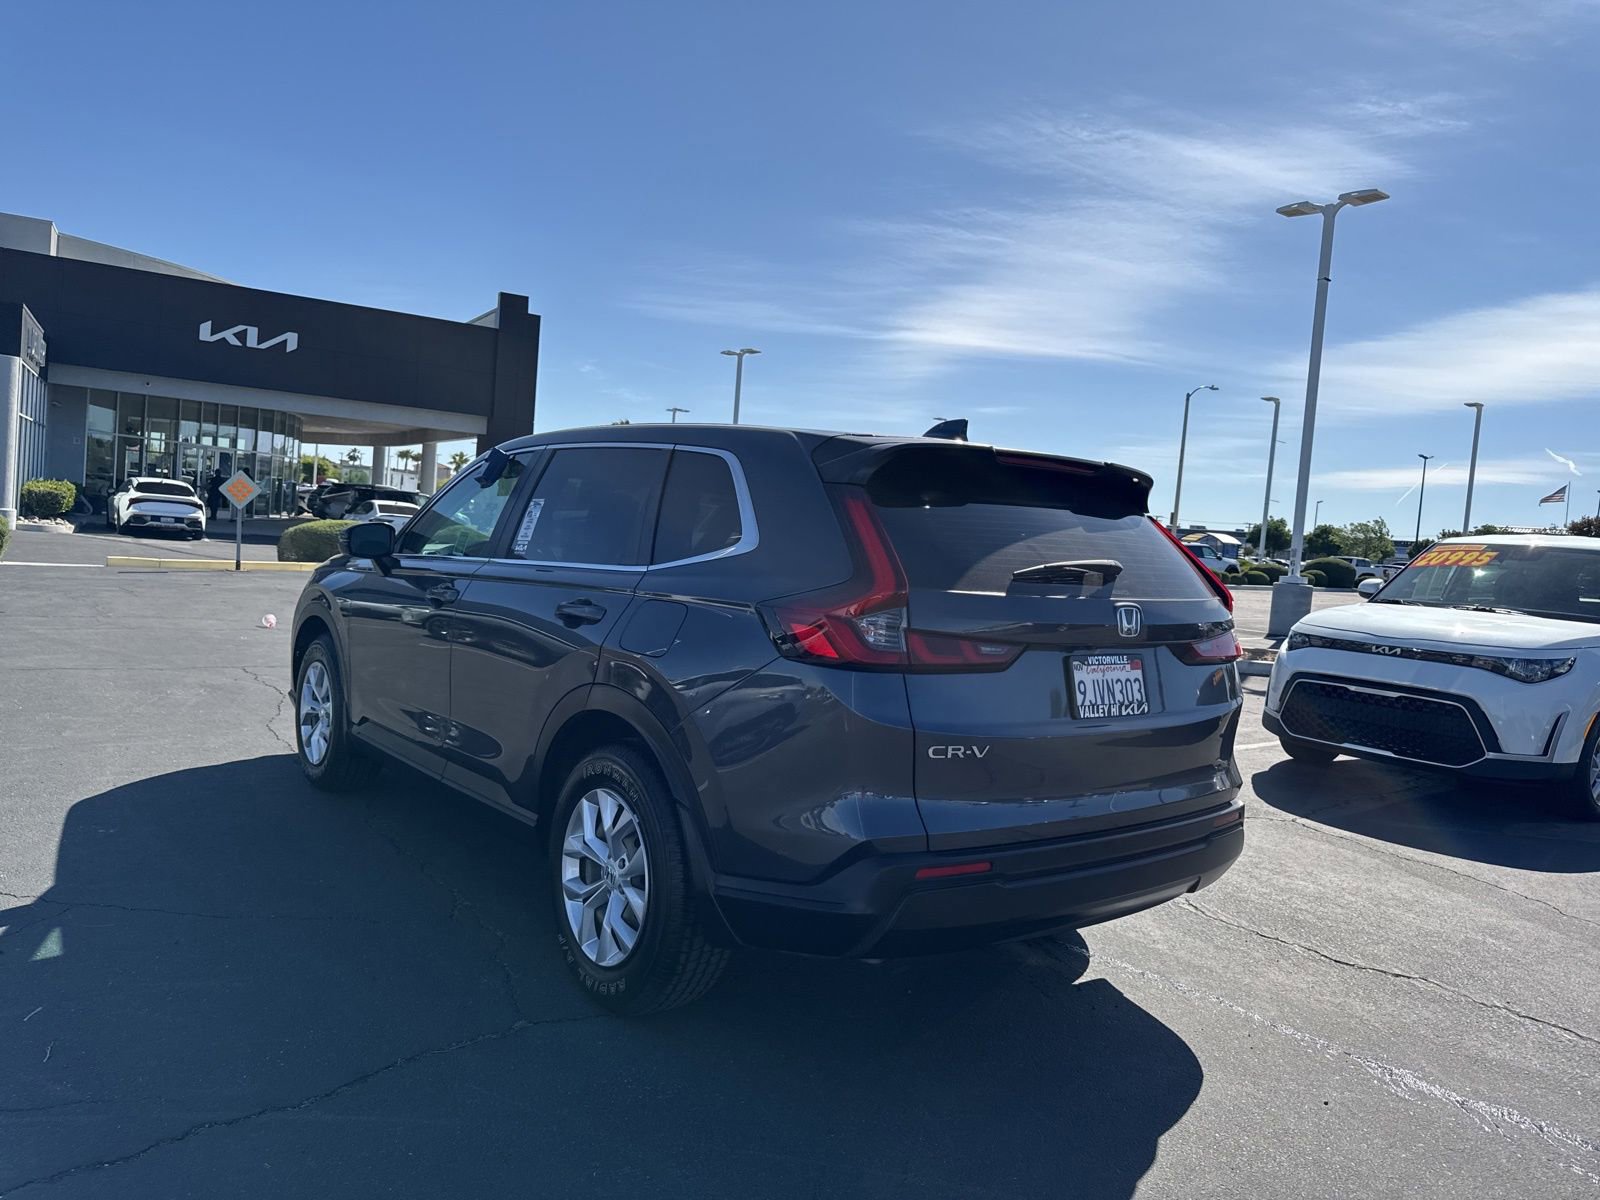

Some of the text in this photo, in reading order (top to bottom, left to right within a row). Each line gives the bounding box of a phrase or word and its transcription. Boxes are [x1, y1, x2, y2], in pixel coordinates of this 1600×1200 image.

[199, 320, 298, 353] KIA
[1413, 551, 1500, 567] 20995
[1372, 645, 1401, 656] KIA
[1087, 655, 1128, 665] VICTORVILLE
[1077, 677, 1144, 706] 9JVN303
[1079, 702, 1148, 719] VALLEY HI KIA
[928, 745, 990, 759] CR-V
